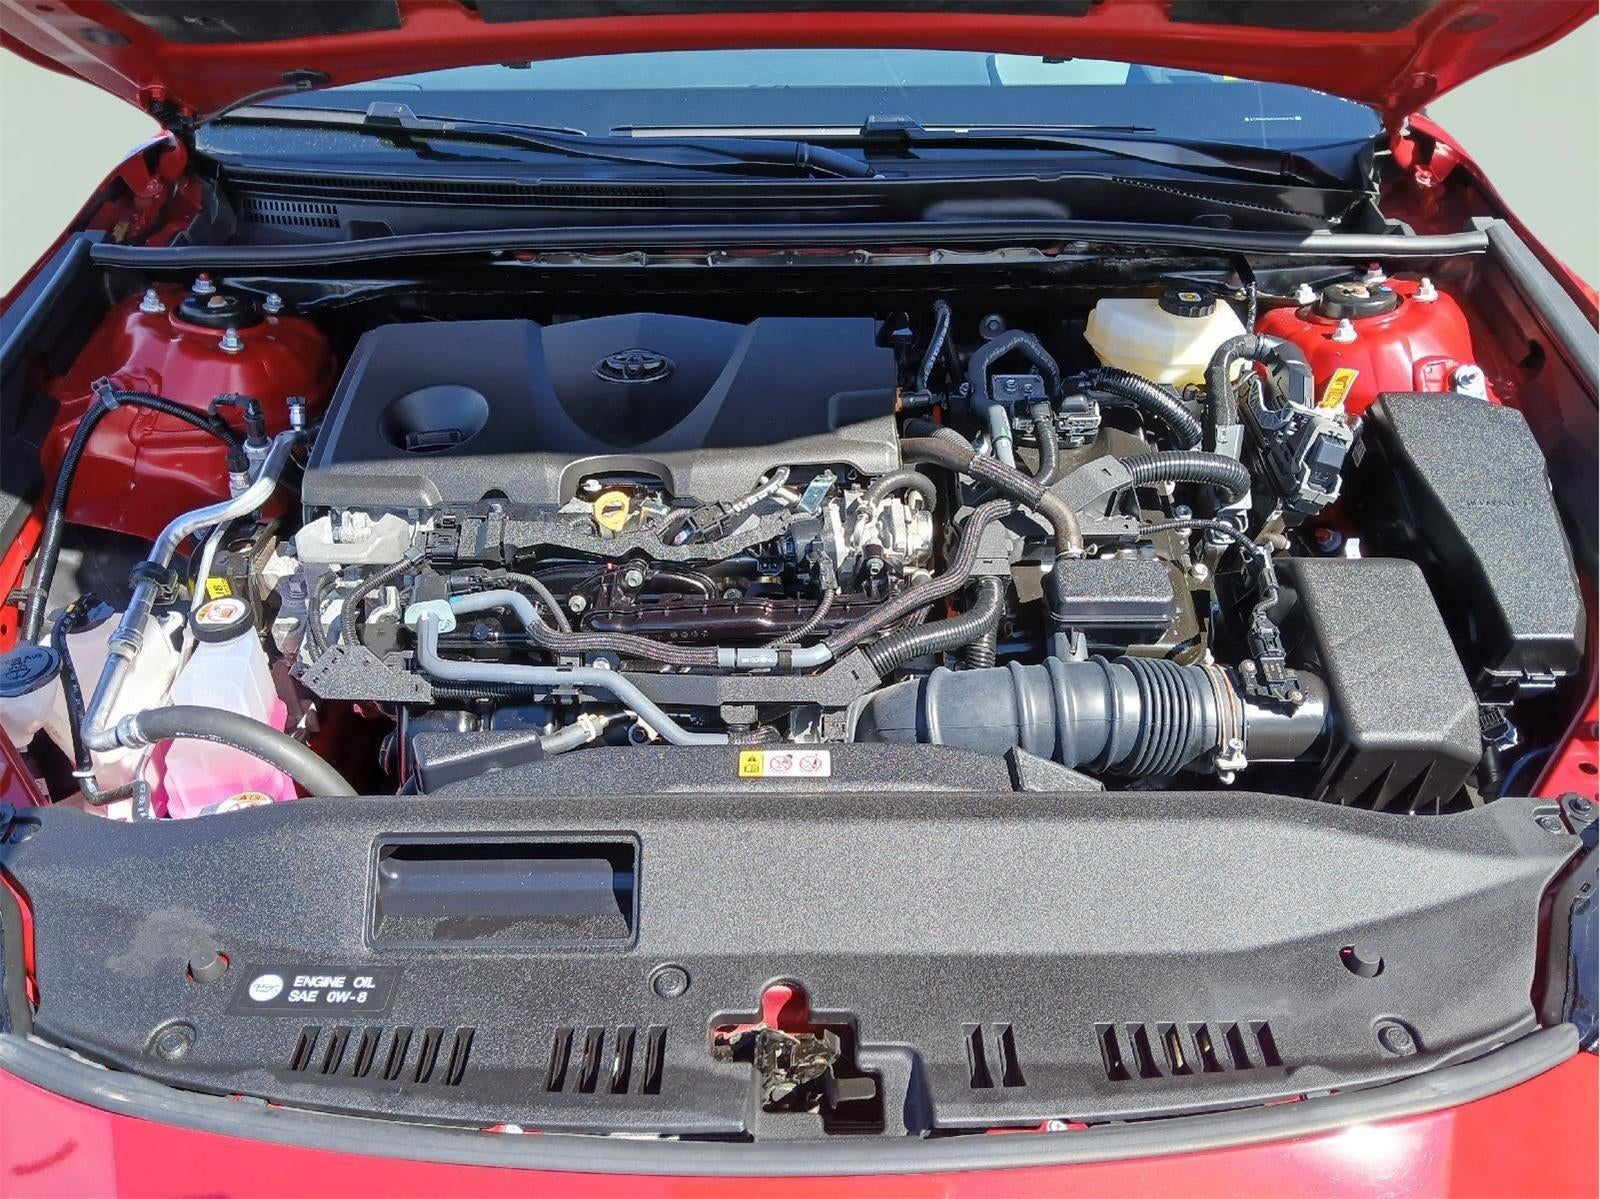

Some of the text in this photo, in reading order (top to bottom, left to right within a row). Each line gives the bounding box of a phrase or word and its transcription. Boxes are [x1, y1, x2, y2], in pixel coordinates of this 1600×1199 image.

[293, 975, 346, 988] ENGINE
[353, 975, 376, 989] OIL
[288, 989, 368, 1004] SAE 0W-8
